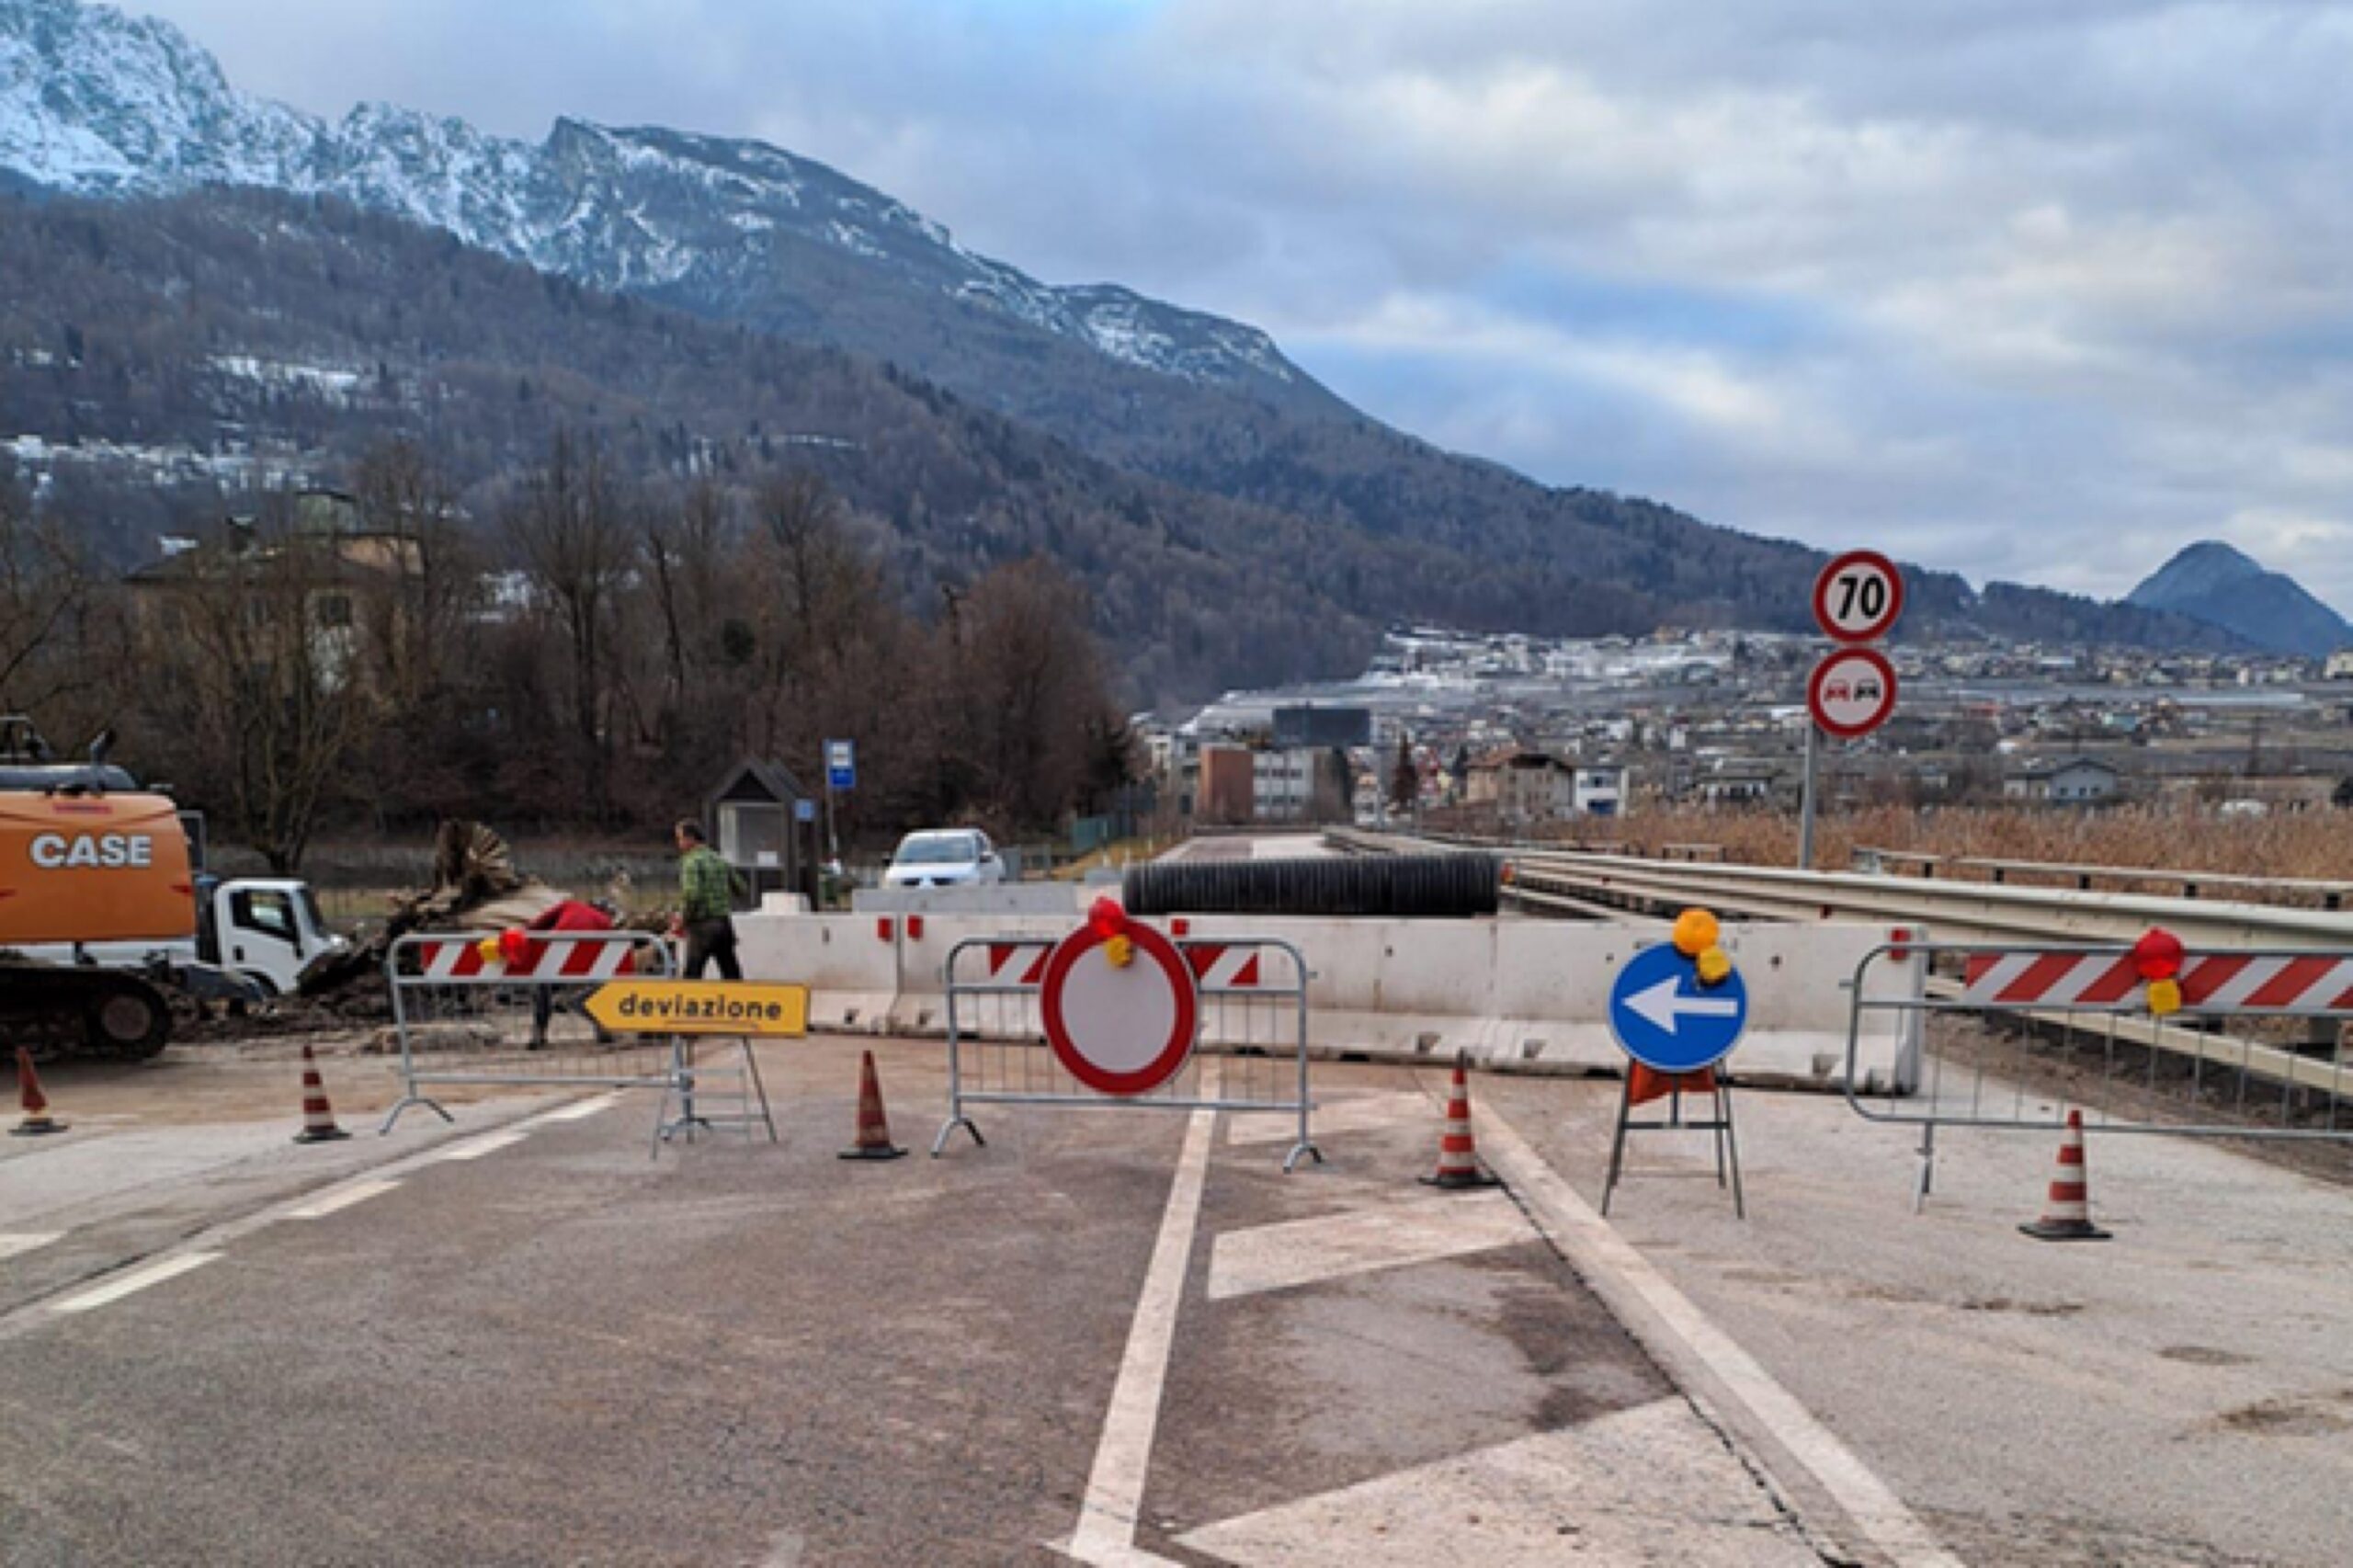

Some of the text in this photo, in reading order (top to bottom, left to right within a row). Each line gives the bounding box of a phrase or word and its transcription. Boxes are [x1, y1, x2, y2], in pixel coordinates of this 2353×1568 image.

[1838, 574, 1885, 619] 70
[30, 834, 152, 868] CASE
[619, 992, 781, 1020] deviazione
